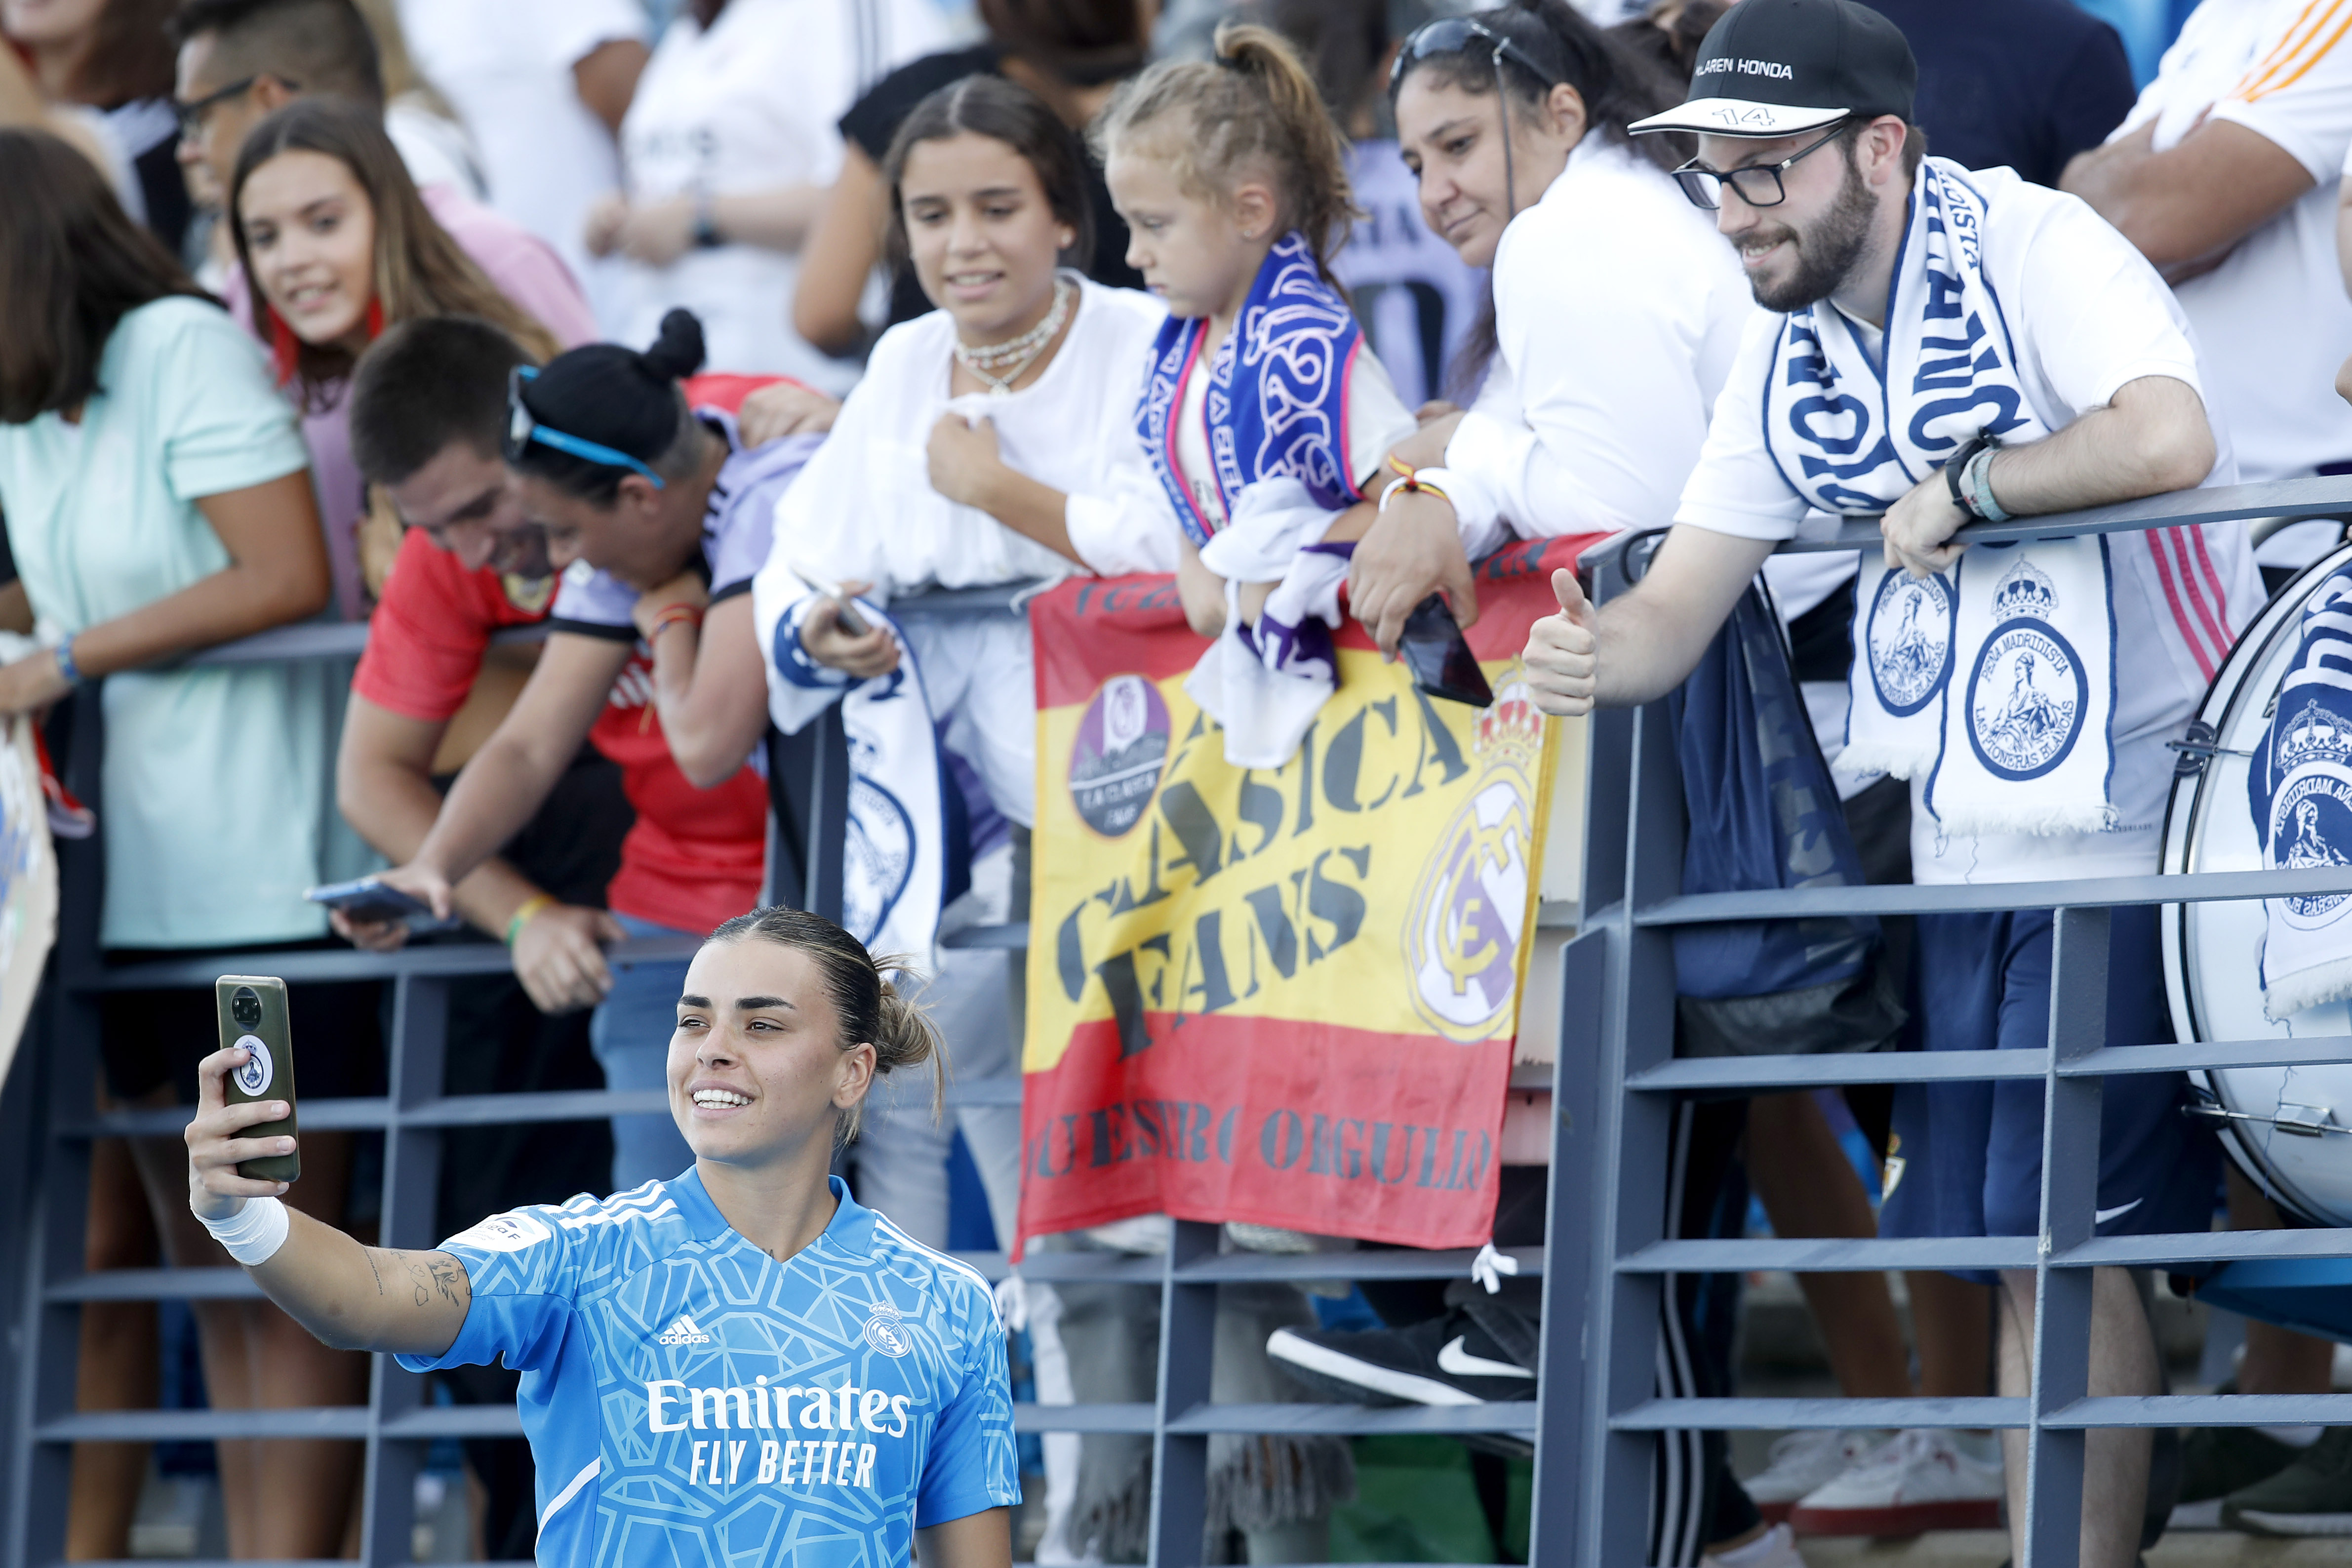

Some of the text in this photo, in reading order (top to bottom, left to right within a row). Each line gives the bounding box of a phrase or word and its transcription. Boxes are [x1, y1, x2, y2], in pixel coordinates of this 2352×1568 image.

[1737, 58, 1793, 80] HONDA
[1712, 108, 1775, 126] 14
[2001, 633, 2069, 678] MADRIDISTA
[1975, 699, 2074, 768] LAS PIONERAS BLANCAS
[1093, 843, 1372, 1064] FANS
[478, 1223, 509, 1234] Liga
[659, 1333, 710, 1345] adidas
[644, 1374, 912, 1439] Emirates
[689, 1440, 877, 1488] FLY BETTER
